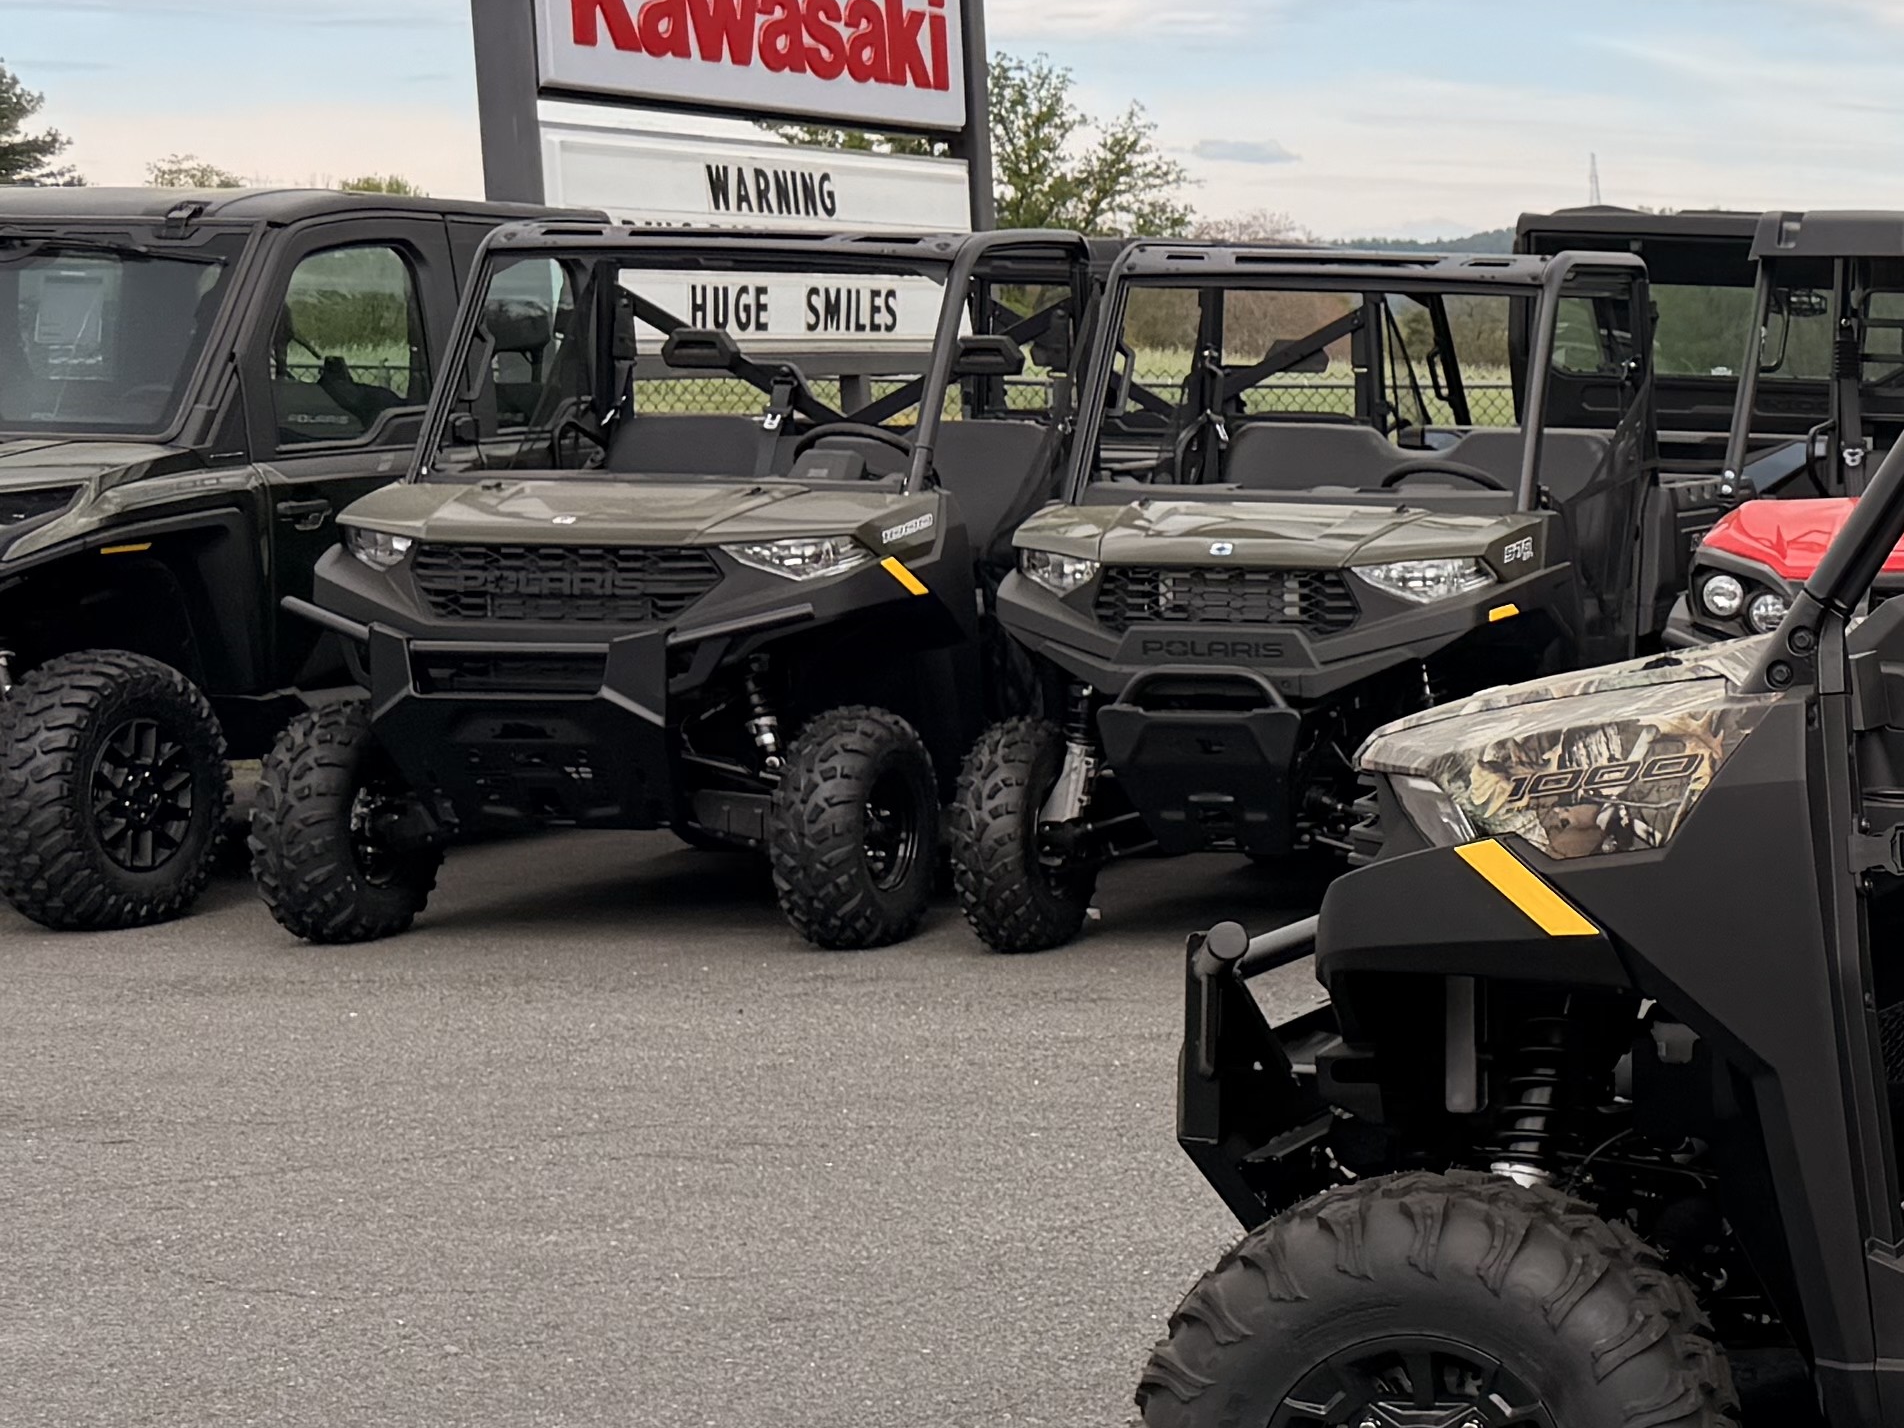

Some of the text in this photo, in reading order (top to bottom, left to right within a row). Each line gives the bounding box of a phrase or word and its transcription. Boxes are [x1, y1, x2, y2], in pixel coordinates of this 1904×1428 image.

[706, 165, 837, 218] WARNING
[691, 285, 897, 332] HUGE SMILES
[459, 571, 645, 596] POLARIS
[1141, 639, 1283, 658] POLARIS
[1507, 753, 1705, 803] 1000
